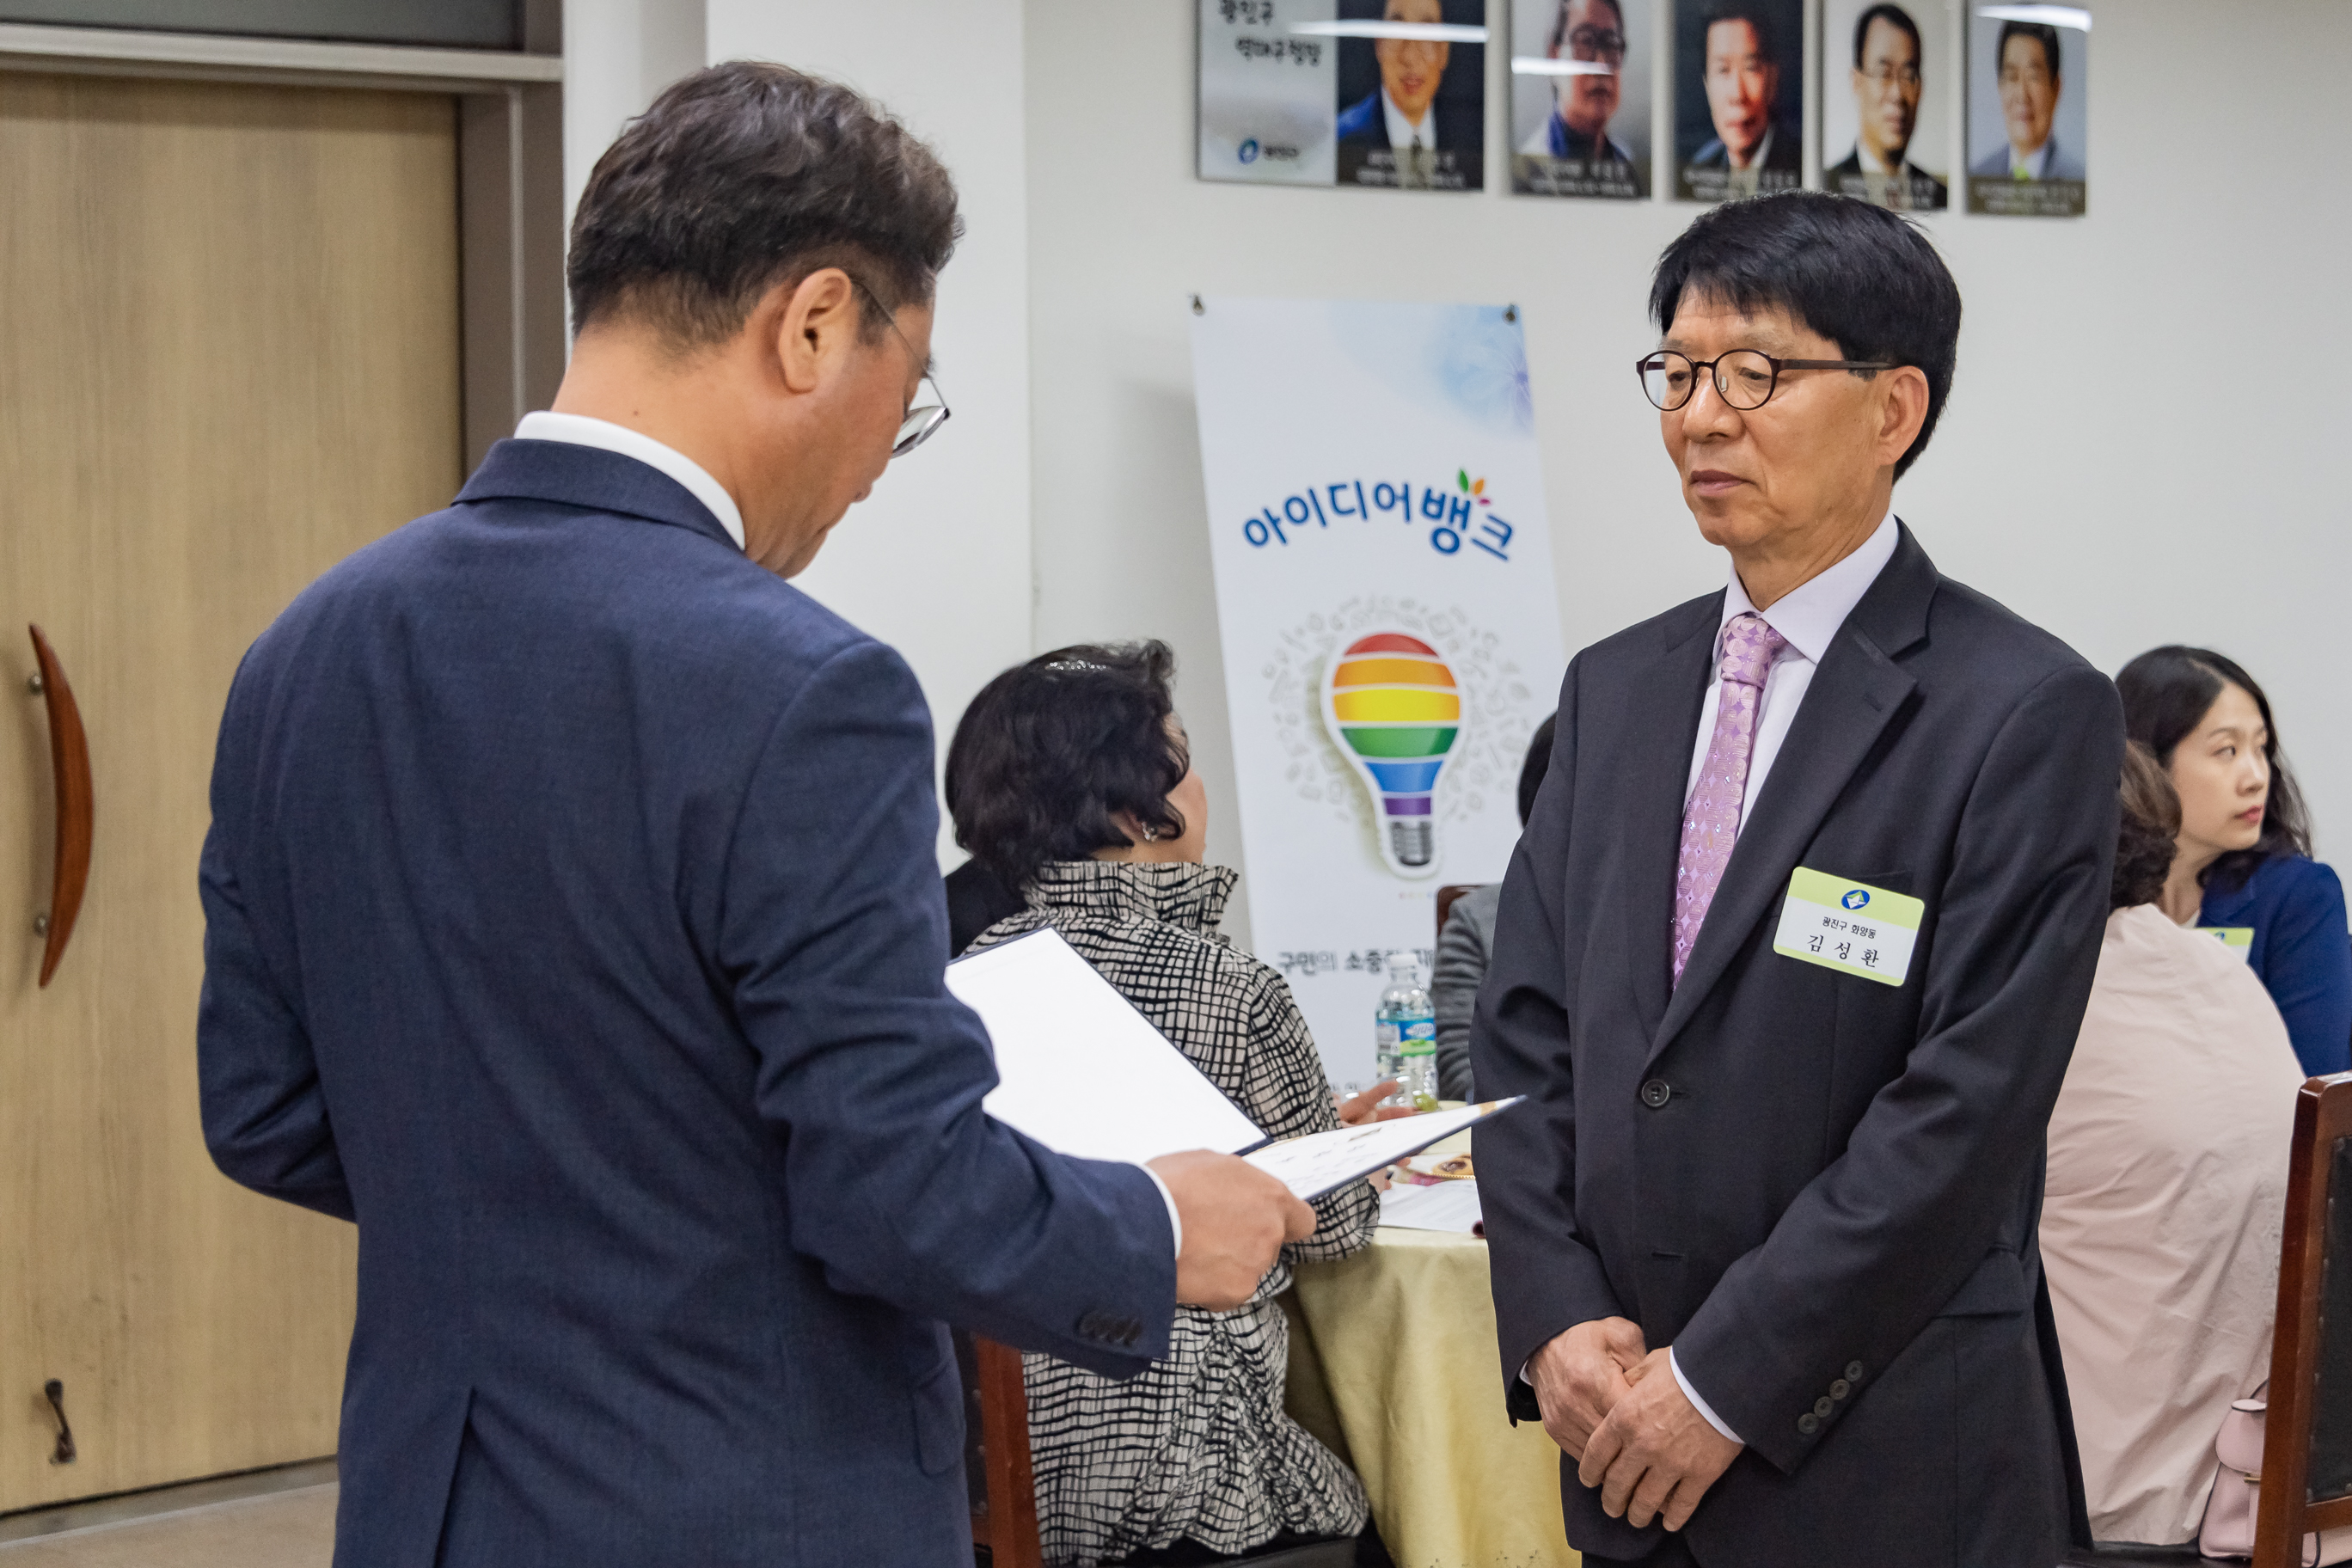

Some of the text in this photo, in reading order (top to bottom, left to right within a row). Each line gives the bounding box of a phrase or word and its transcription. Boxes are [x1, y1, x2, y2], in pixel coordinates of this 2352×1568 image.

[1242, 480, 1514, 561] 아이디어뱅크
[1822, 916, 1877, 939] 광진구 화양동
[1277, 951, 1337, 976] 구민의
